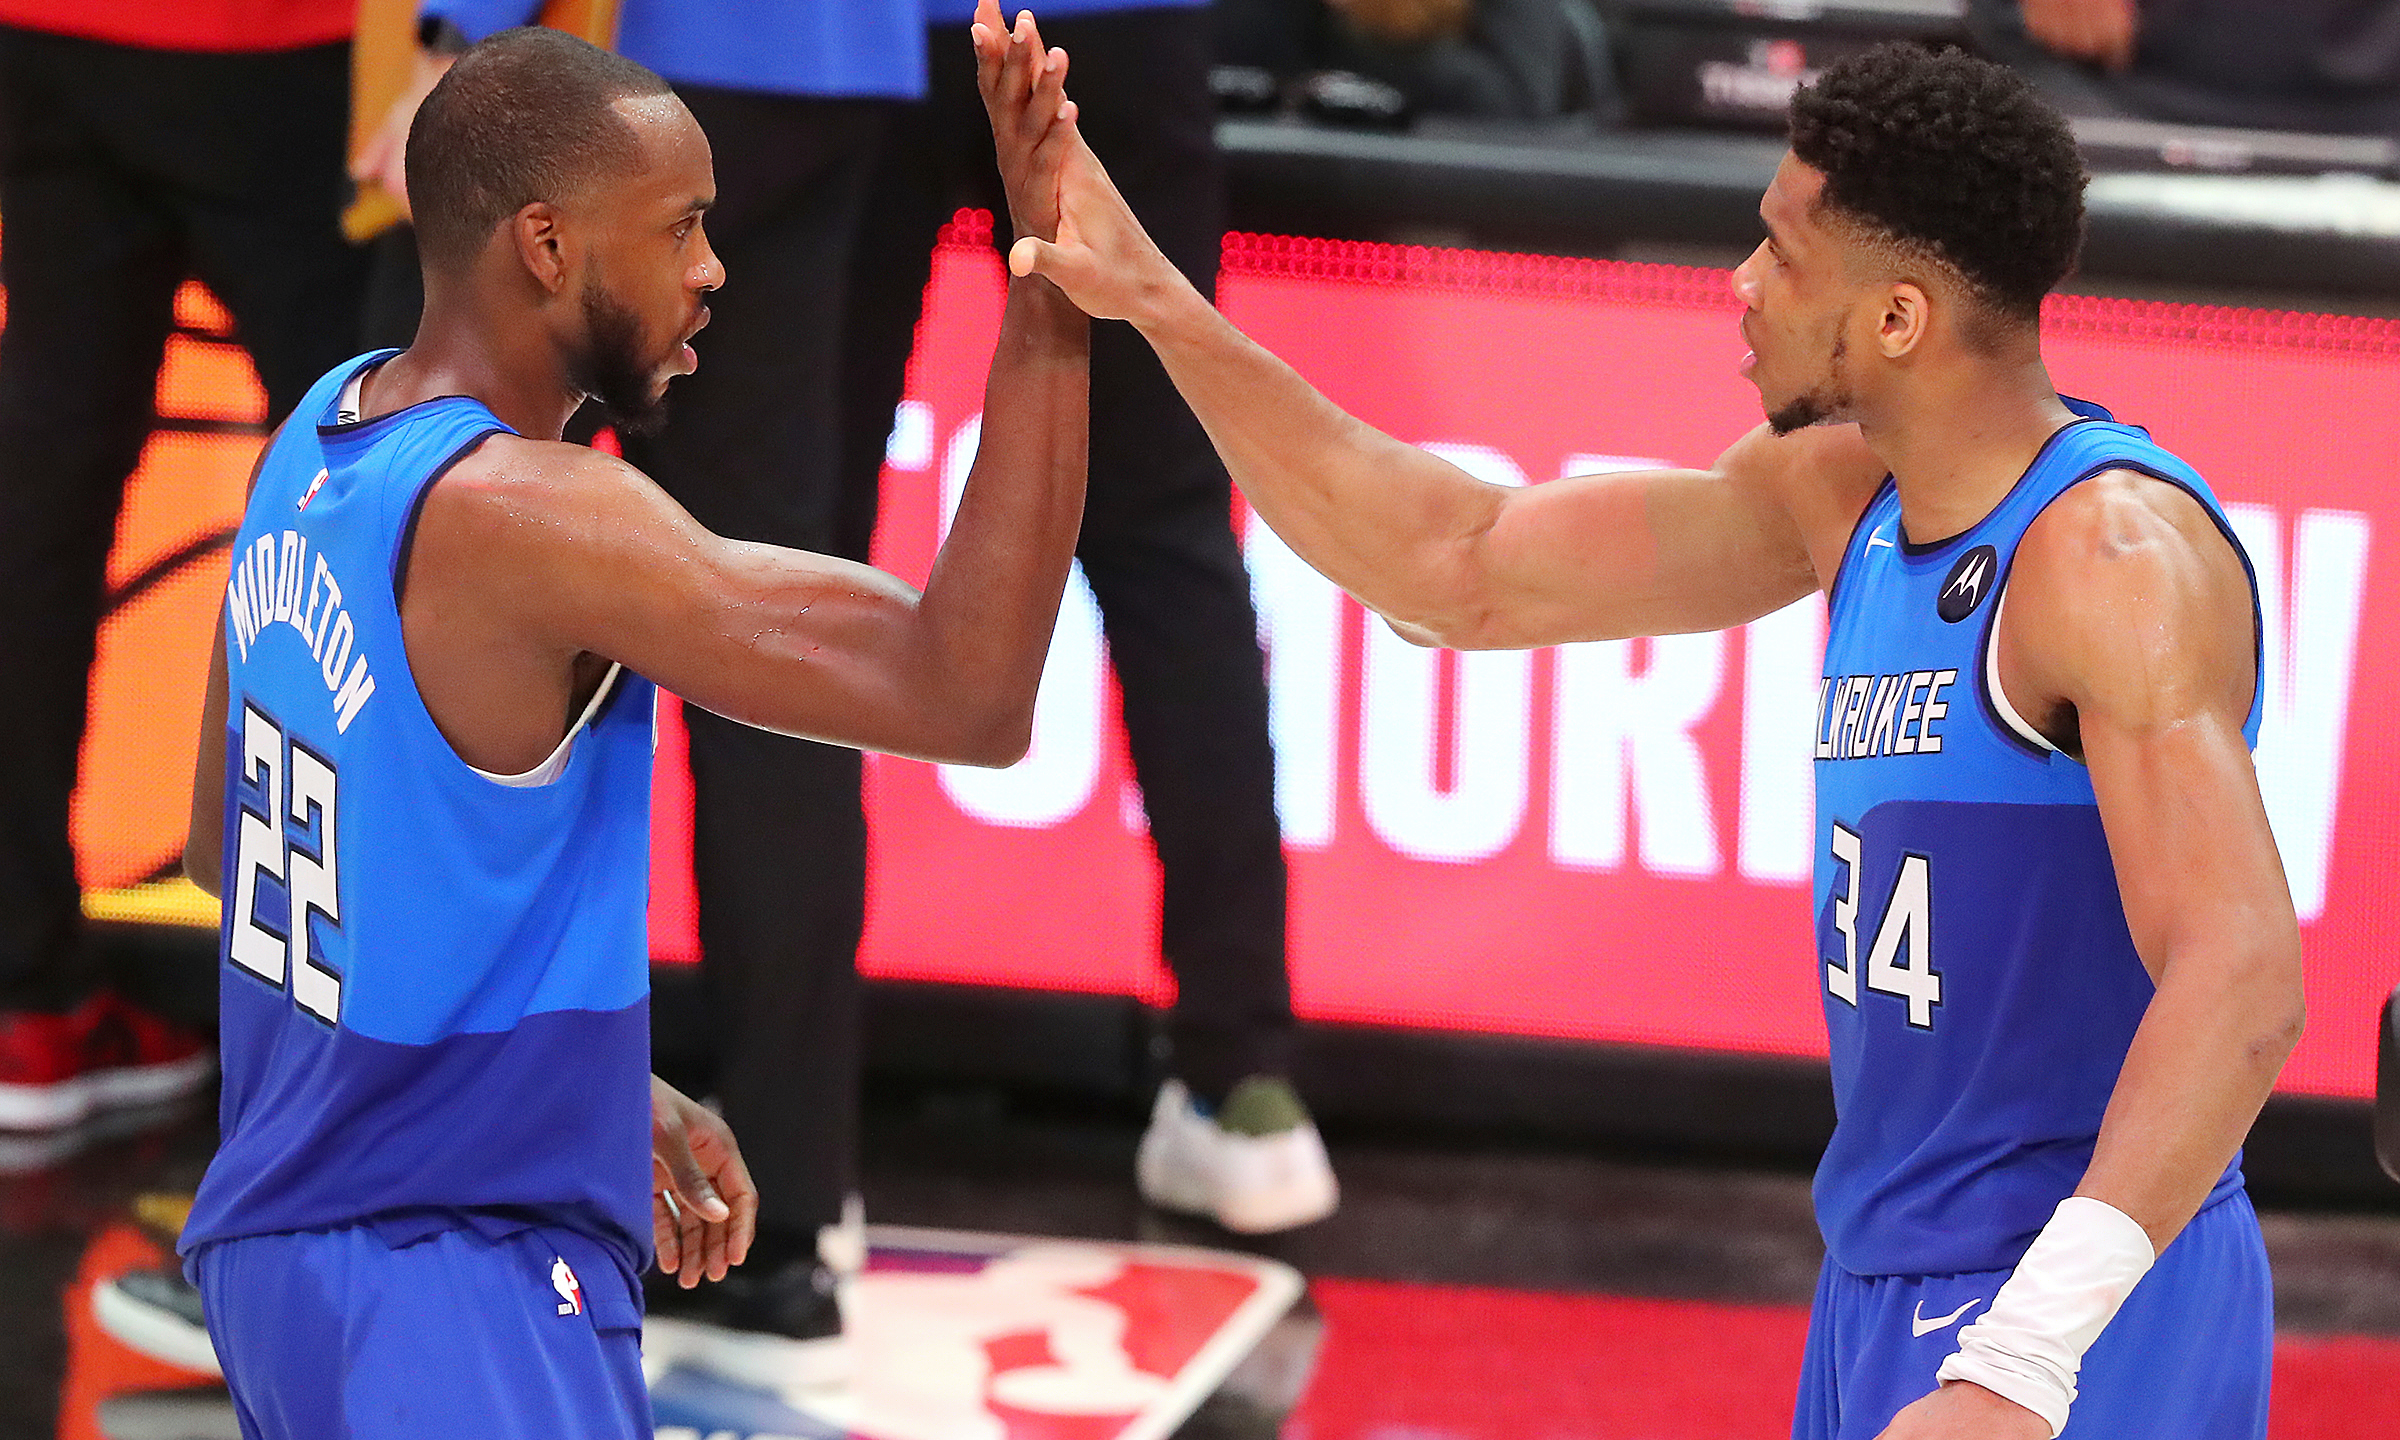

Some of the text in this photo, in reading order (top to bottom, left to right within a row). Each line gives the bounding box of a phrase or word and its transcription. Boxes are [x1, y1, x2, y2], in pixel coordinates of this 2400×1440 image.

[227, 530, 377, 735] MIDDLETON
[229, 698, 342, 1029] 22
[1826, 819, 1944, 1032] 34
